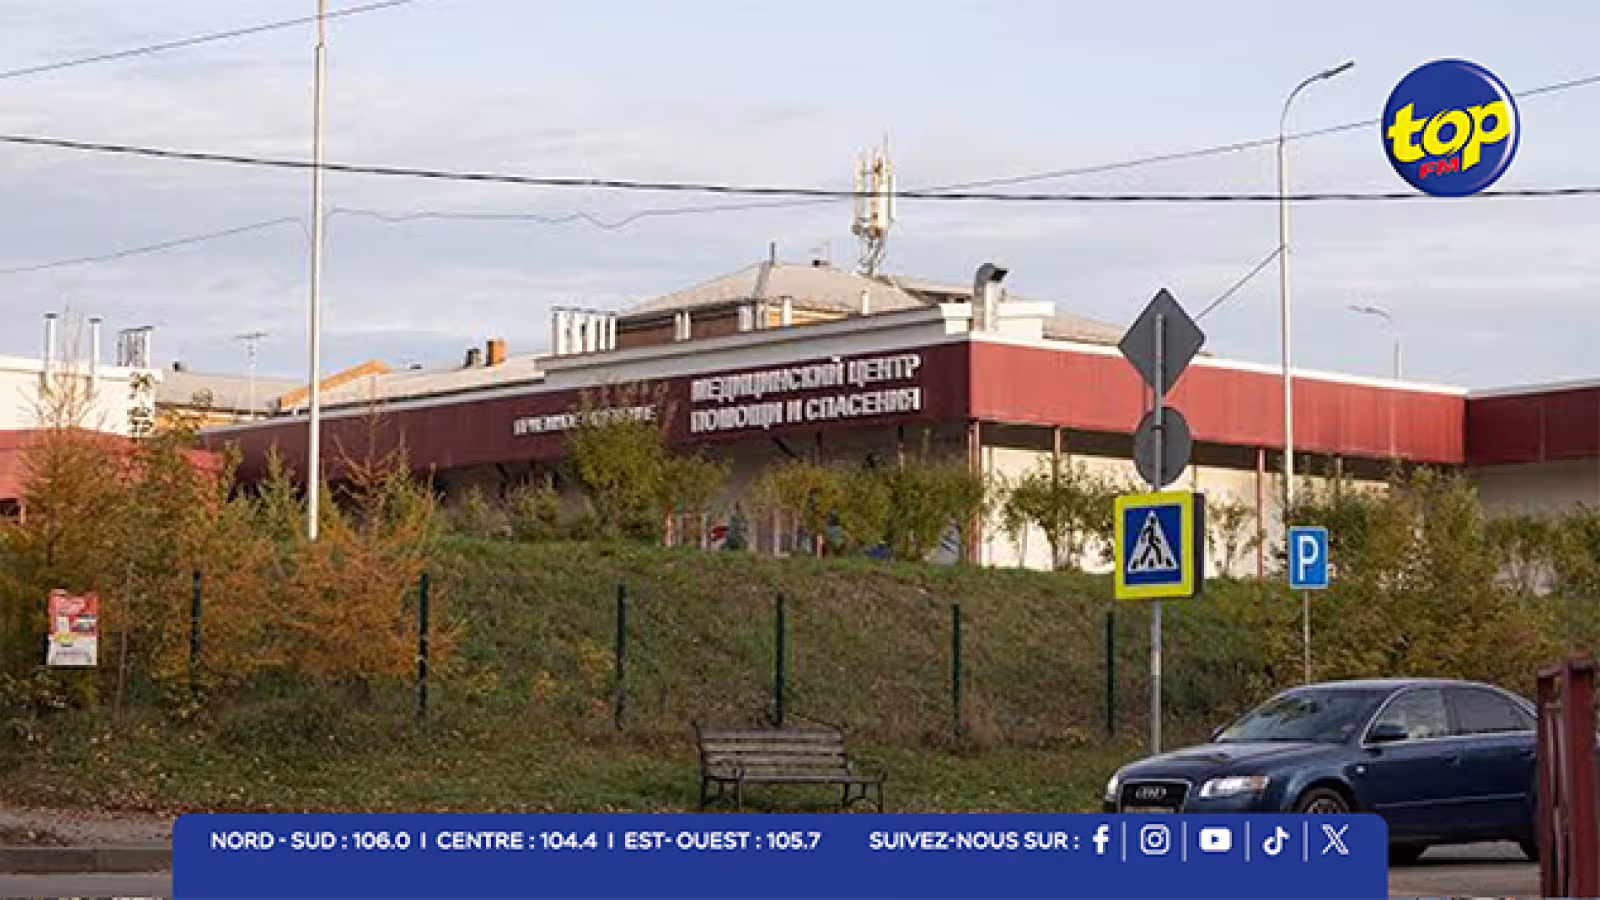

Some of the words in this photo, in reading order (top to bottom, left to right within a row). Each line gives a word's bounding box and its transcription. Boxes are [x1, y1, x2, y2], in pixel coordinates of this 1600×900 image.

[691, 356, 844, 402] МЕДИЦИНСКИЙ
[848, 354, 920, 387] ЦЕНТР
[691, 401, 783, 433] ПОМОЩИ
[786, 399, 802, 422] И
[806, 387, 920, 420] СПАСЕНИЯ
[1297, 535, 1319, 581] P
